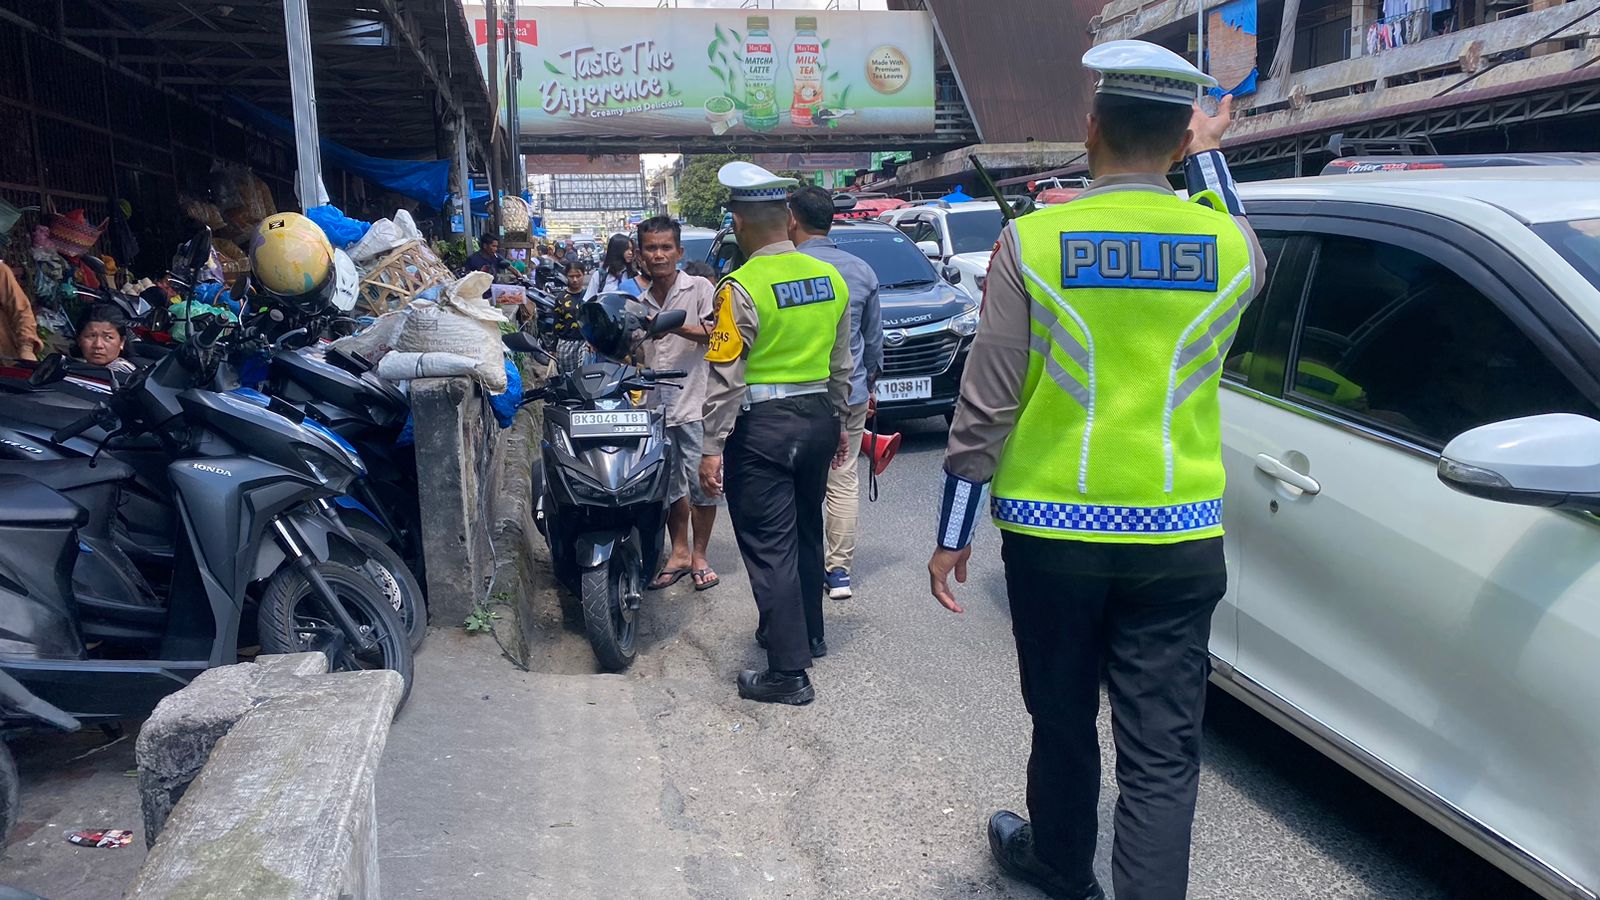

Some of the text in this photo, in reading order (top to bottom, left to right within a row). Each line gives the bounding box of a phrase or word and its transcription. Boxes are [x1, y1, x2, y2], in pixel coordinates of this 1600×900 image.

[560, 40, 675, 80] Taste The
[796, 56, 817, 64] MILK
[749, 66, 770, 74] LATTE
[800, 66, 815, 75] TEA
[538, 75, 664, 117] Difference
[590, 98, 684, 119] Creamy and Delicious
[1065, 238, 1217, 284] POLISI
[775, 276, 834, 307] POLISI
[900, 313, 932, 324] SPORT
[915, 379, 930, 392] HT
[192, 463, 232, 477] HONDA
